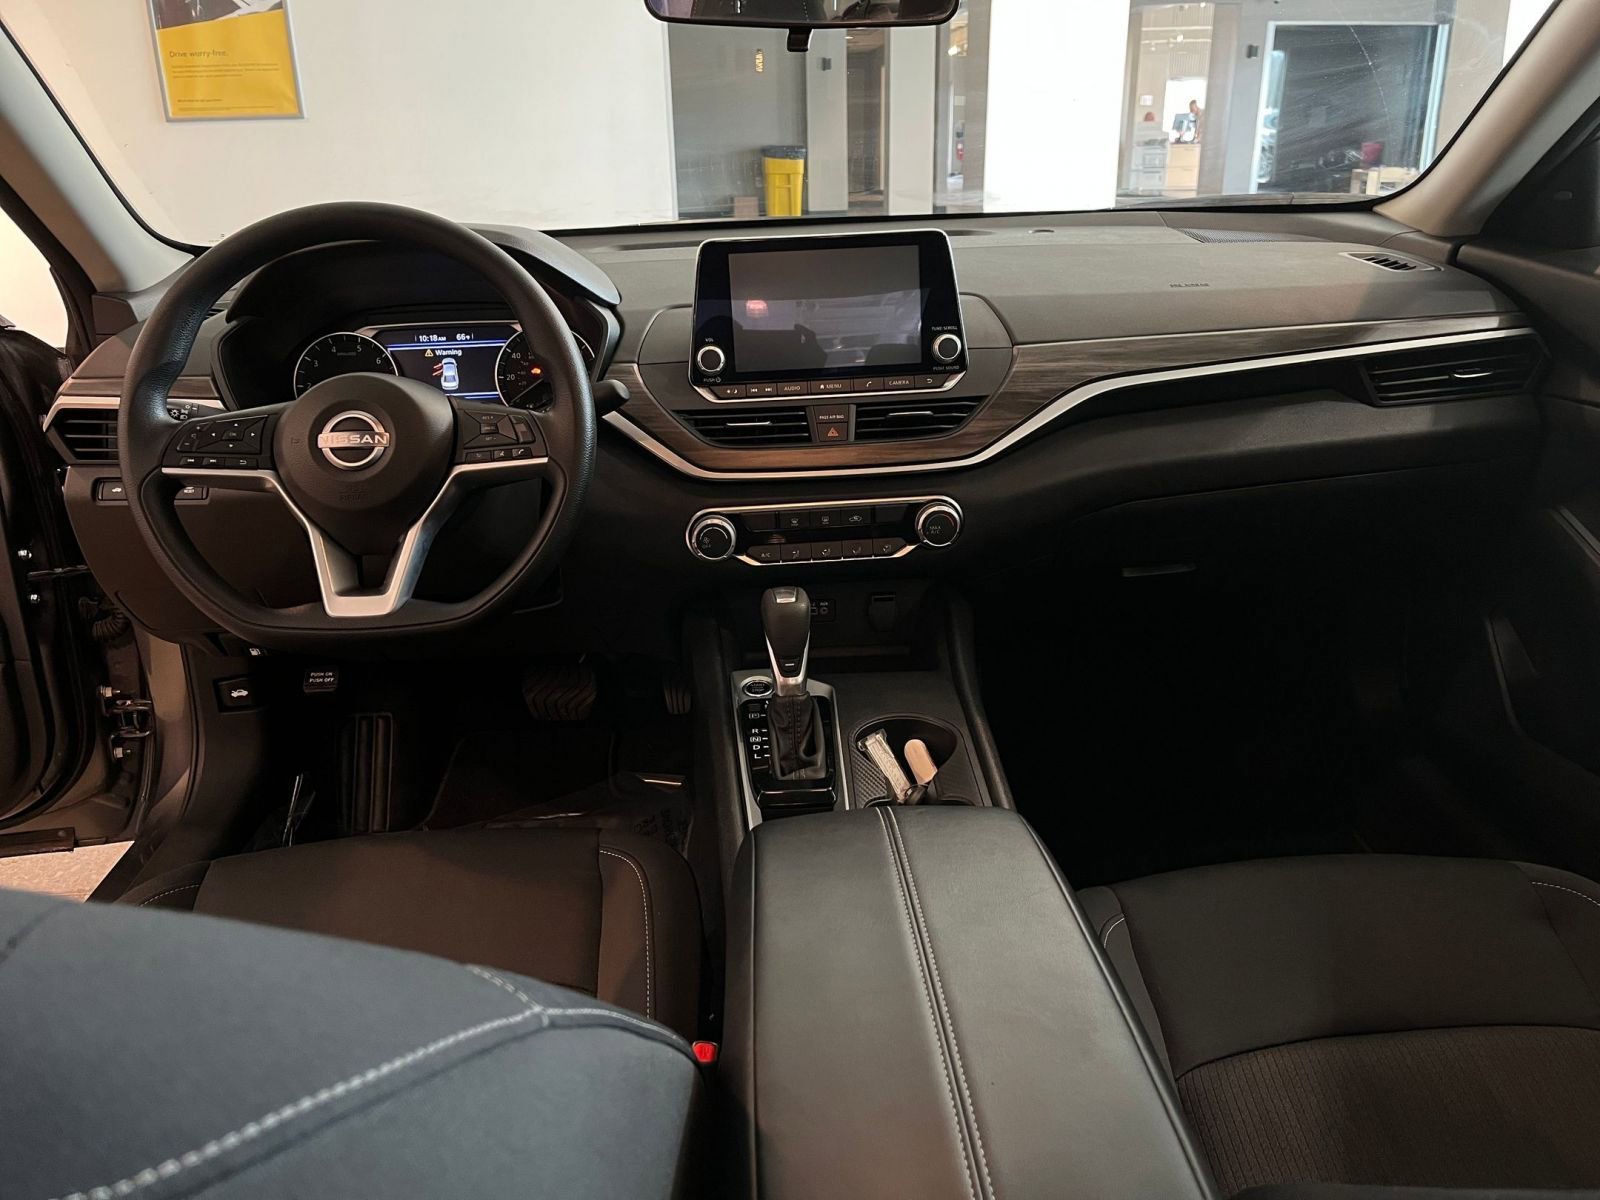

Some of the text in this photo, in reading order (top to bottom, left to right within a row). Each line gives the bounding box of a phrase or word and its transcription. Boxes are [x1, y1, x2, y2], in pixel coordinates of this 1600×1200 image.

[169, 50, 187, 58] Drive
[356, 344, 363, 353] 5
[434, 348, 463, 357] Warning
[511, 352, 522, 360] 40
[313, 359, 320, 368] 3
[375, 357, 383, 365] 6
[506, 373, 517, 381] 20
[320, 434, 388, 446] NISSAN
